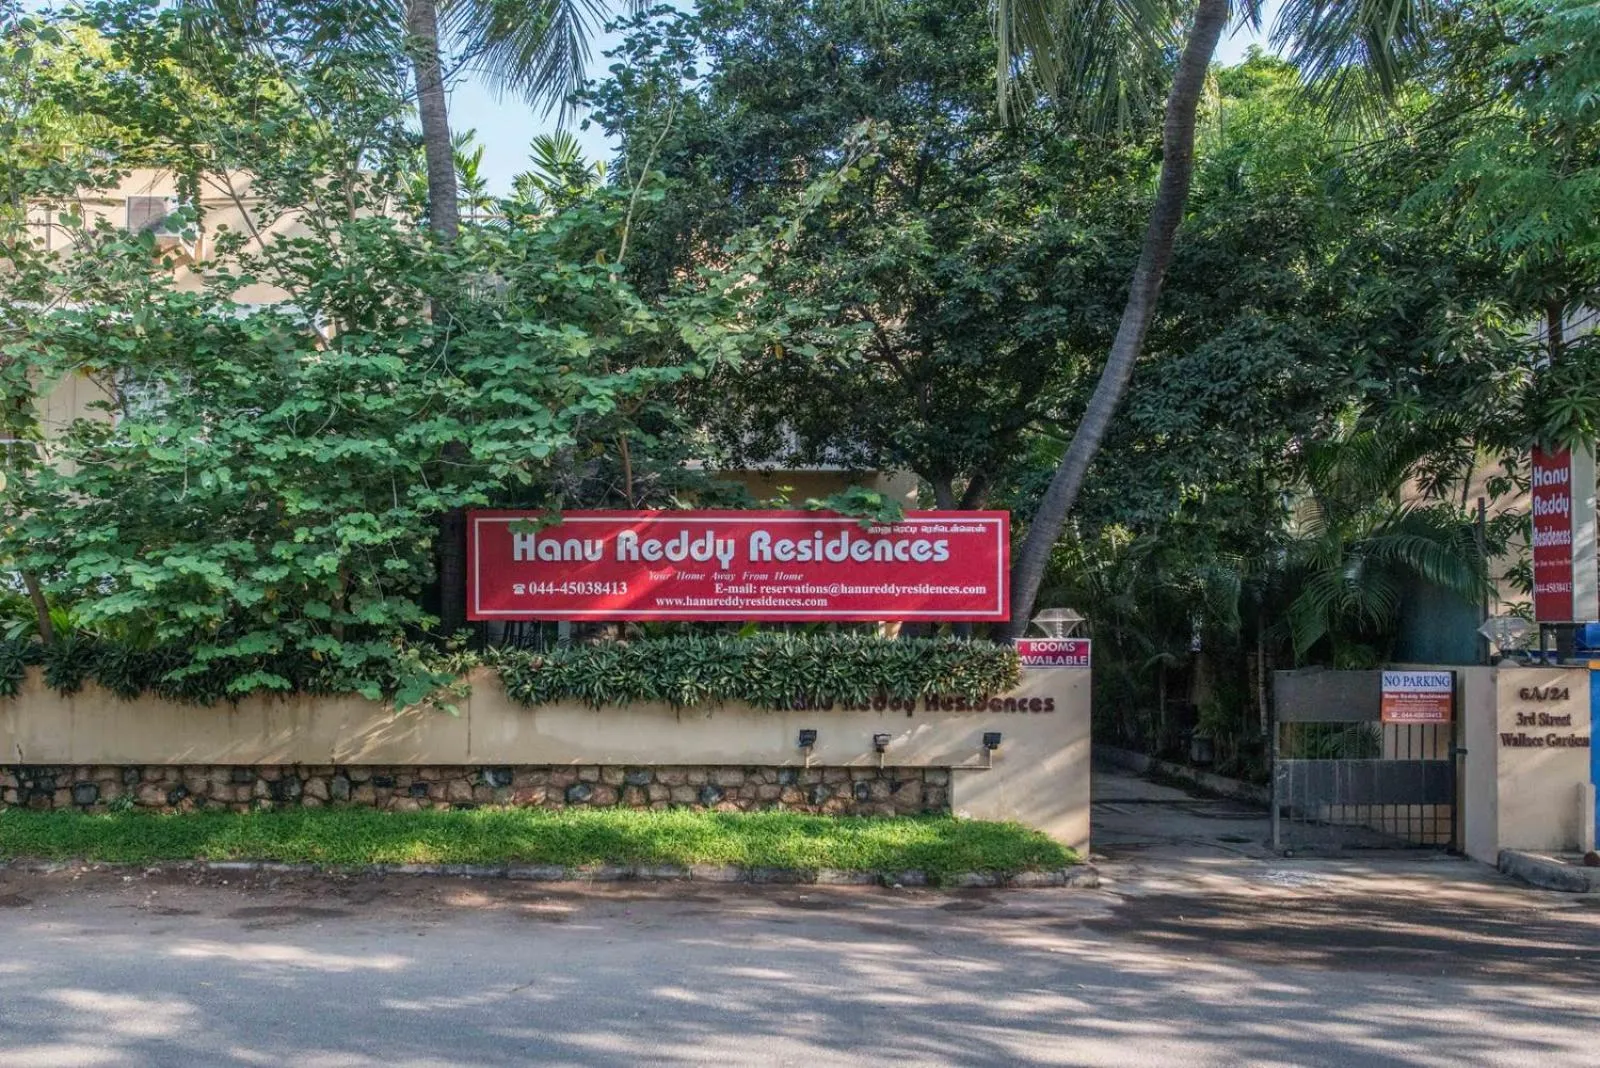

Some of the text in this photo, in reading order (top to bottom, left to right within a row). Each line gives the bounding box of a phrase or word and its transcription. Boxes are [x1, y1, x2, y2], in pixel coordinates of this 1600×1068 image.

[1534, 466, 1568, 487] Hanu
[1535, 493, 1569, 518] Reddy
[1534, 526, 1571, 546] Residences
[513, 530, 950, 569] Hanu Reddy Residences
[649, 571, 804, 581] Your Home Away From Home
[528, 582, 628, 595] 044-45038413
[715, 583, 986, 597] E-mail: reservations@hanureddyresidences.com
[656, 596, 828, 608] www.hanureddyresidences.com
[1030, 642, 1075, 652] ROOMS
[1020, 655, 1087, 665] AVAILABLE
[1384, 675, 1449, 687] NO PARKING
[1519, 686, 1570, 702] 6A/24
[1516, 711, 1571, 727] 3rd Street
[1500, 733, 1590, 747] Wallace Garden
